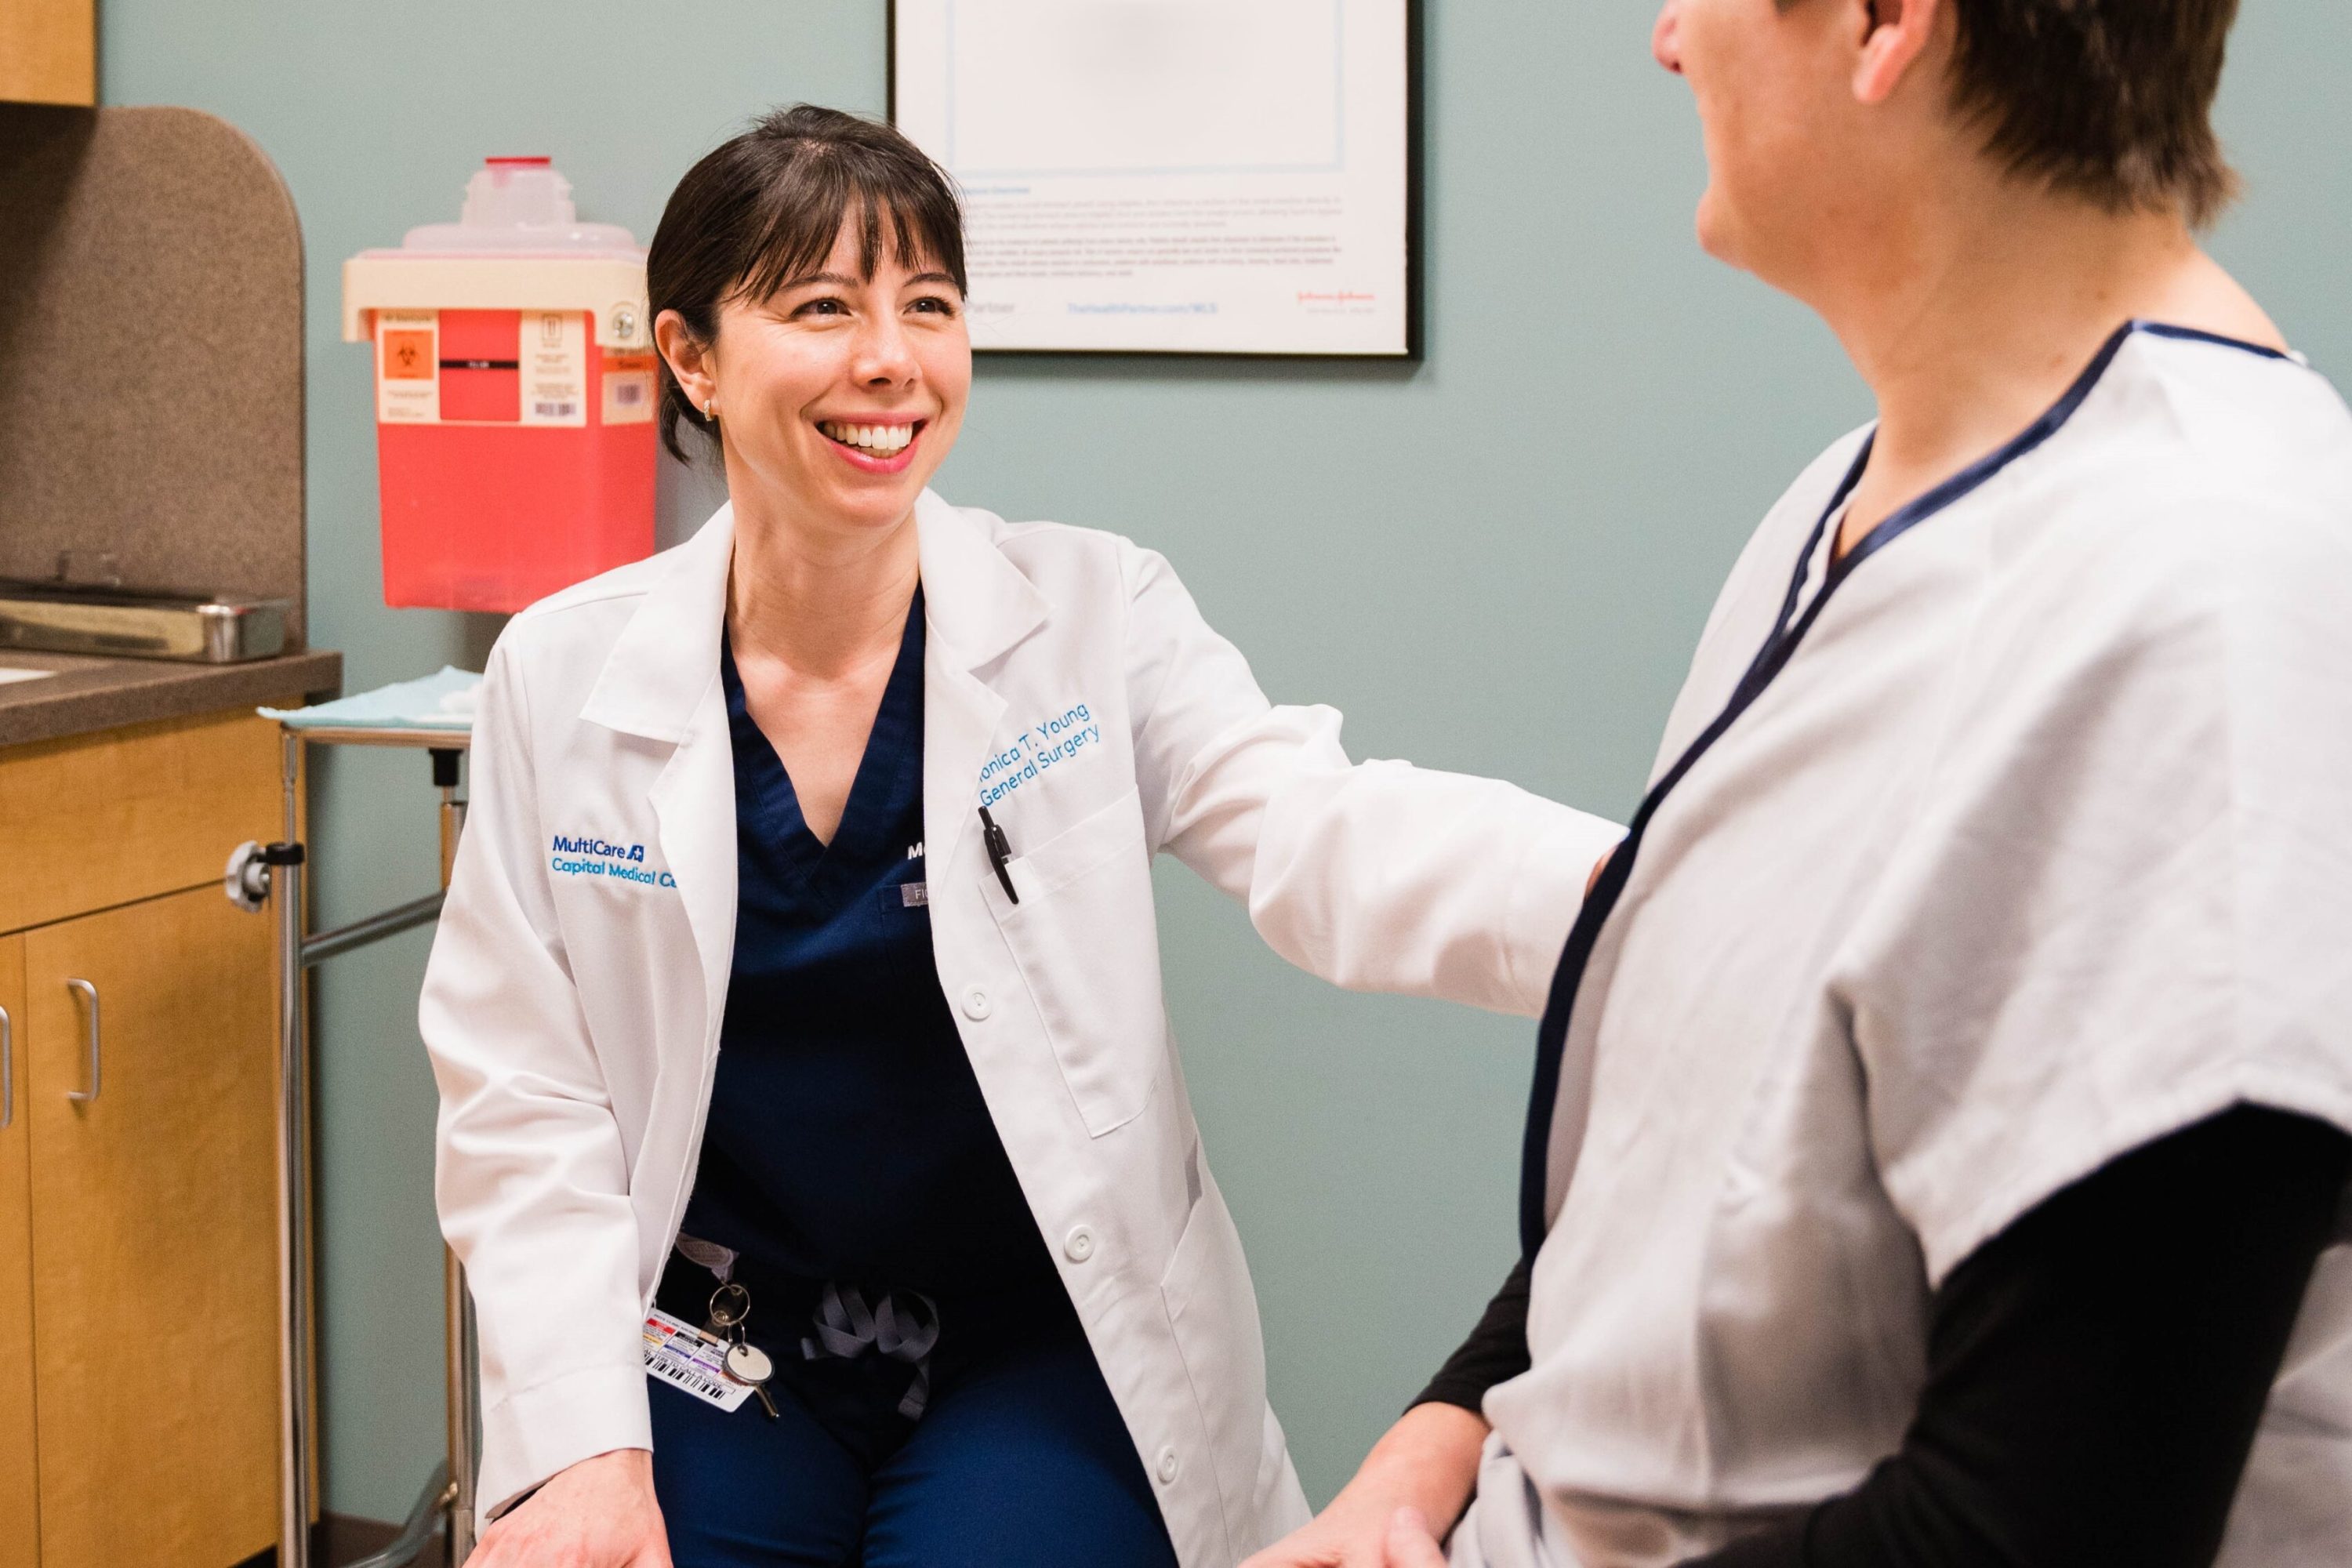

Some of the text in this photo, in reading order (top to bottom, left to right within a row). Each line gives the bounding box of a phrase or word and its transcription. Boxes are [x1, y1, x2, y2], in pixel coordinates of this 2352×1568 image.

[979, 703, 1090, 782] onica T. Young
[980, 724, 1100, 806] General Surgery
[553, 836, 626, 858] MultiCare
[908, 842, 925, 859] M
[552, 858, 605, 875] Capital
[609, 863, 656, 885] Medical
